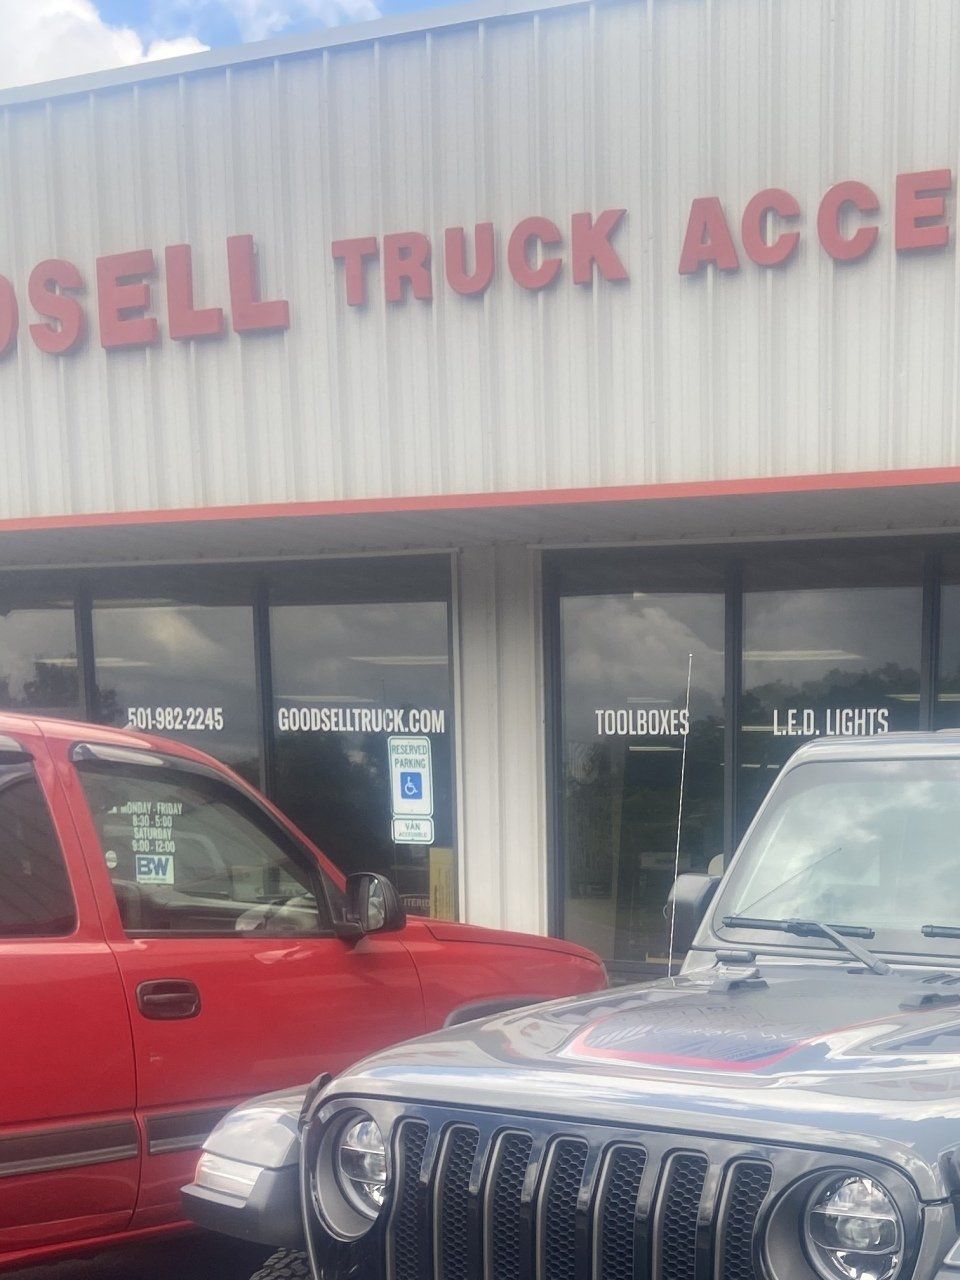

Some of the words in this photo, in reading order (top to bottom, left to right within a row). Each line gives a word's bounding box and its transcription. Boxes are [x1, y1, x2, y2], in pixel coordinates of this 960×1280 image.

[331, 208, 630, 307] TRUCK
[128, 707, 223, 731] 501-982-2245
[278, 707, 446, 733] GOODSELLTRUCK.COM
[596, 708, 690, 736] TOOLBOXES
[773, 708, 820, 736] L.E.D.
[826, 708, 889, 736] LIGHTS
[391, 744, 427, 755] RESERVED
[395, 758, 426, 769] PARKING
[157, 802, 182, 814] FRIDAY
[155, 815, 172, 827] 5:00
[404, 822, 421, 831] VAN
[133, 827, 172, 840] SATURDAY
[156, 841, 175, 853] 12:00
